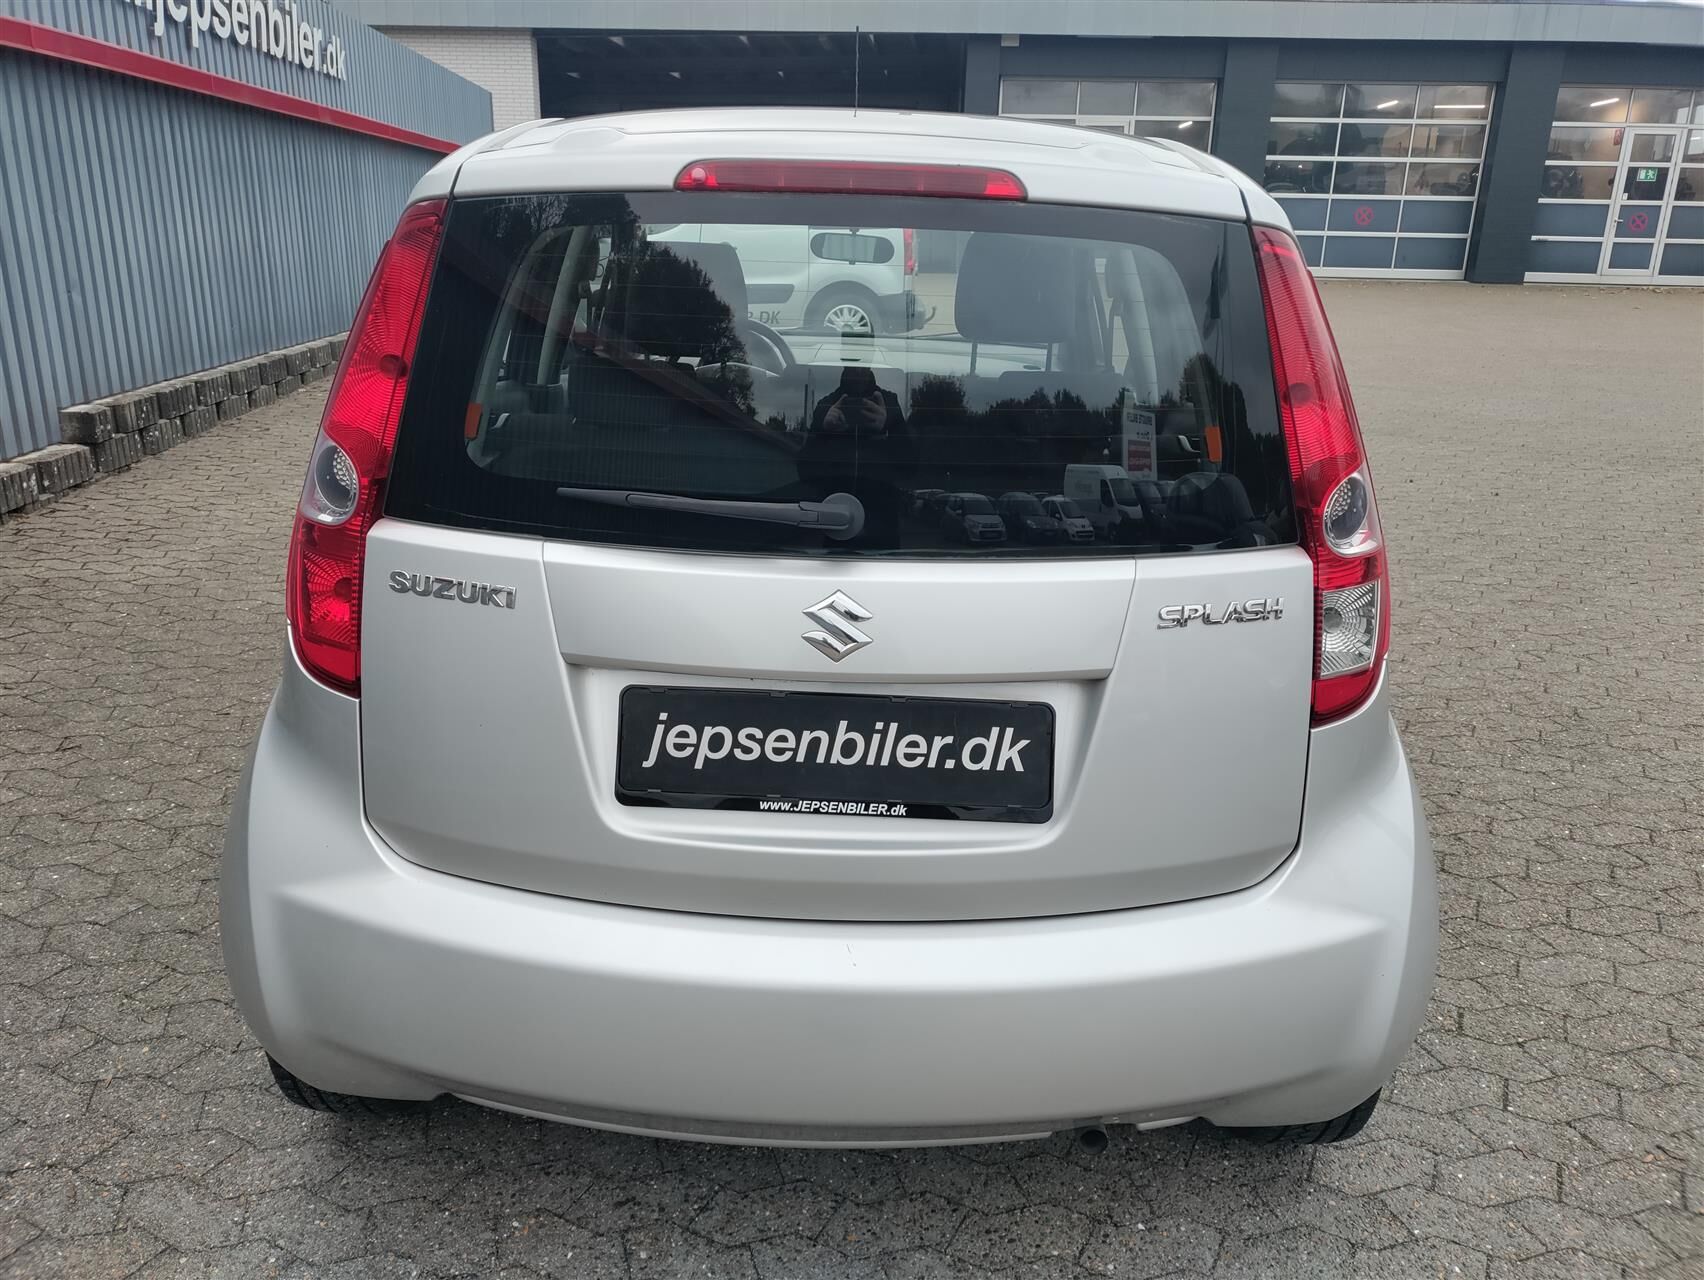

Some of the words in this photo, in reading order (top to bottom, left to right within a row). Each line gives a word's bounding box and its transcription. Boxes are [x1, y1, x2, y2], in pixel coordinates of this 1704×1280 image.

[388, 569, 517, 609] SUZUKI
[1157, 597, 1285, 630] SPLASH
[642, 712, 1031, 773] jepsenbiler.dk
[759, 800, 908, 816] www.JEPSENBILER.dk
